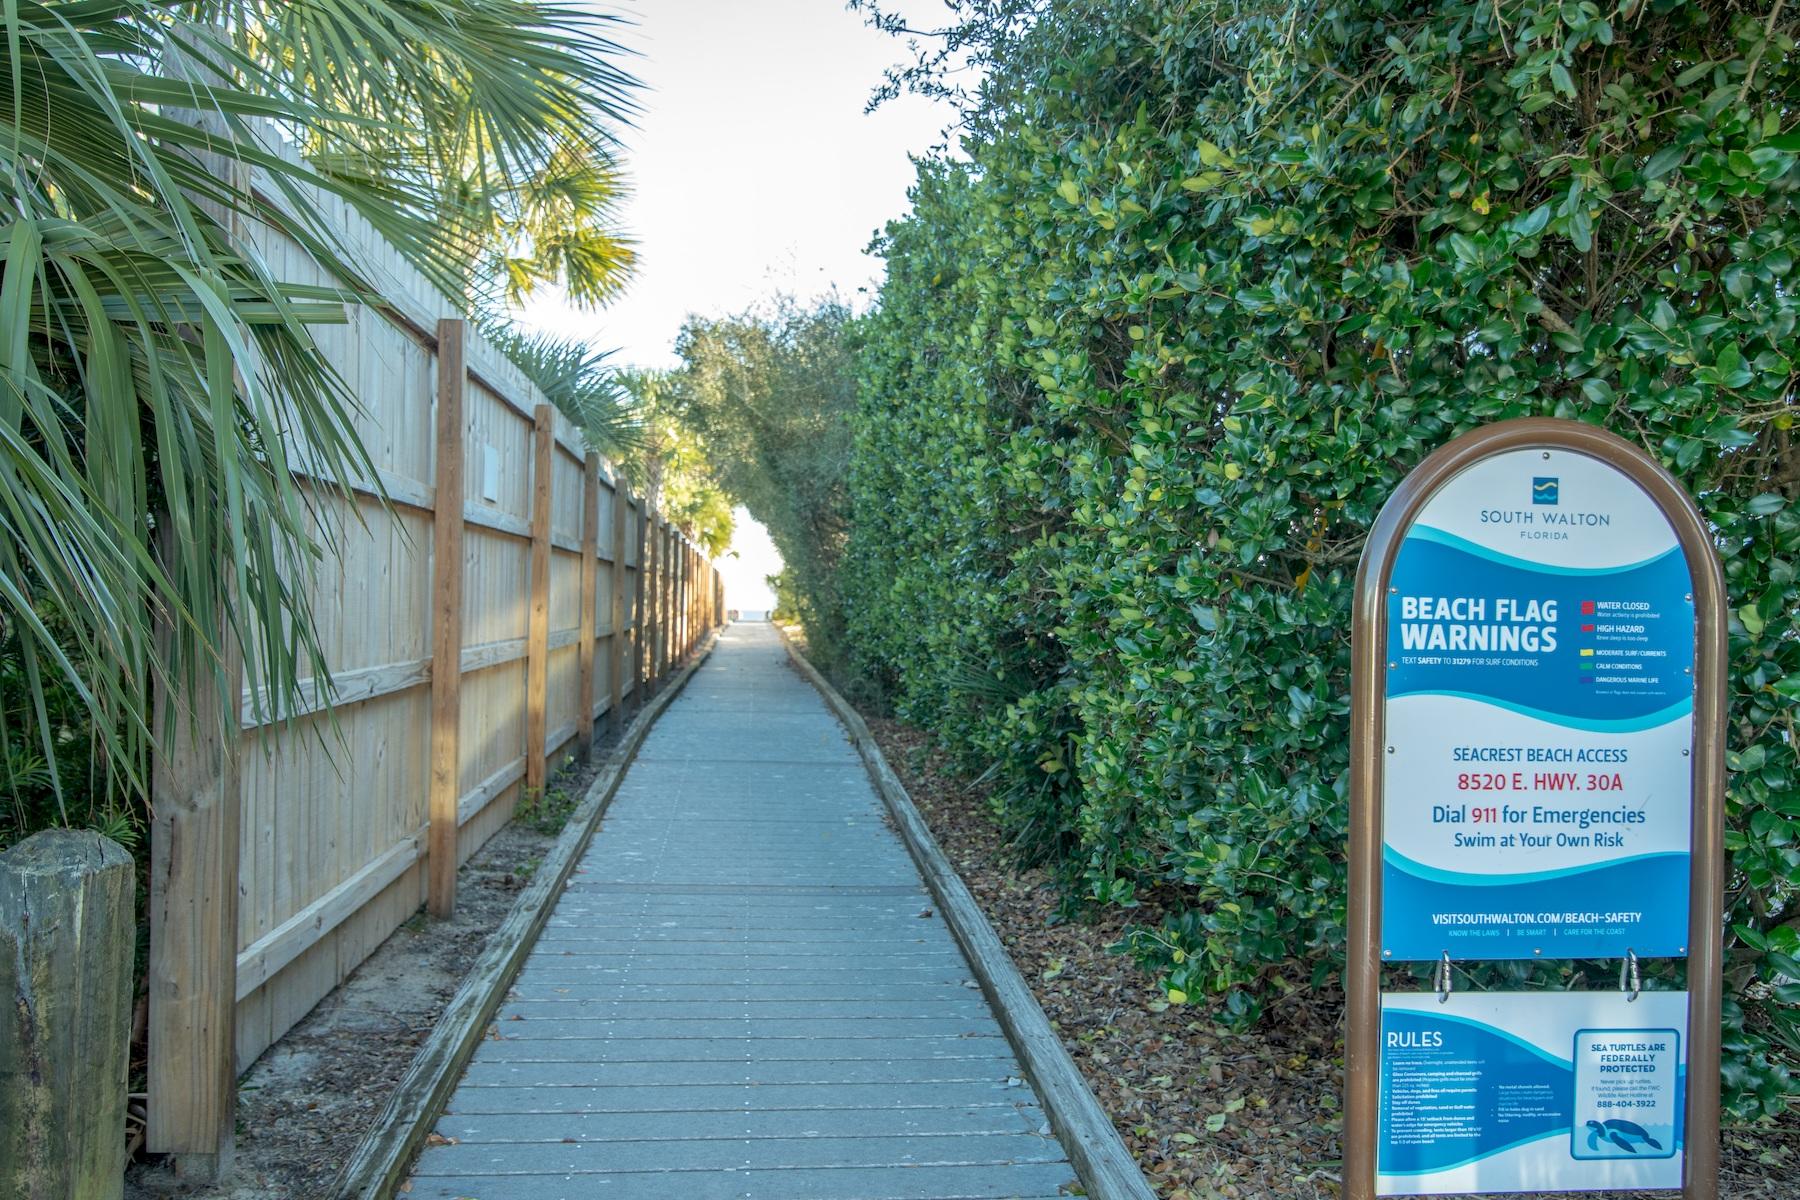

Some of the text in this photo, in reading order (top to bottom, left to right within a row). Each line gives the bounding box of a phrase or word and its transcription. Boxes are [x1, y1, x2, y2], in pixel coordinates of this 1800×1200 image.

[1481, 510, 1609, 526] SOUTH WALTON
[1521, 532, 1568, 540] FLORIDA
[1402, 597, 1557, 622] BEACH FLAG
[1401, 624, 1557, 652] WARNINGS
[1453, 748, 1627, 762] SEACREST BEACH ACCESS
[1458, 774, 1622, 791] 8520 E. HWY. 30A
[1433, 806, 1645, 828] Dial 911 for Emergencies
[1455, 832, 1623, 847] Swim at Your Own Risk
[1432, 912, 1641, 924] VISITSOUTHWALTON.COM/BEACH-SAFETY
[1388, 1032, 1442, 1047] RULES
